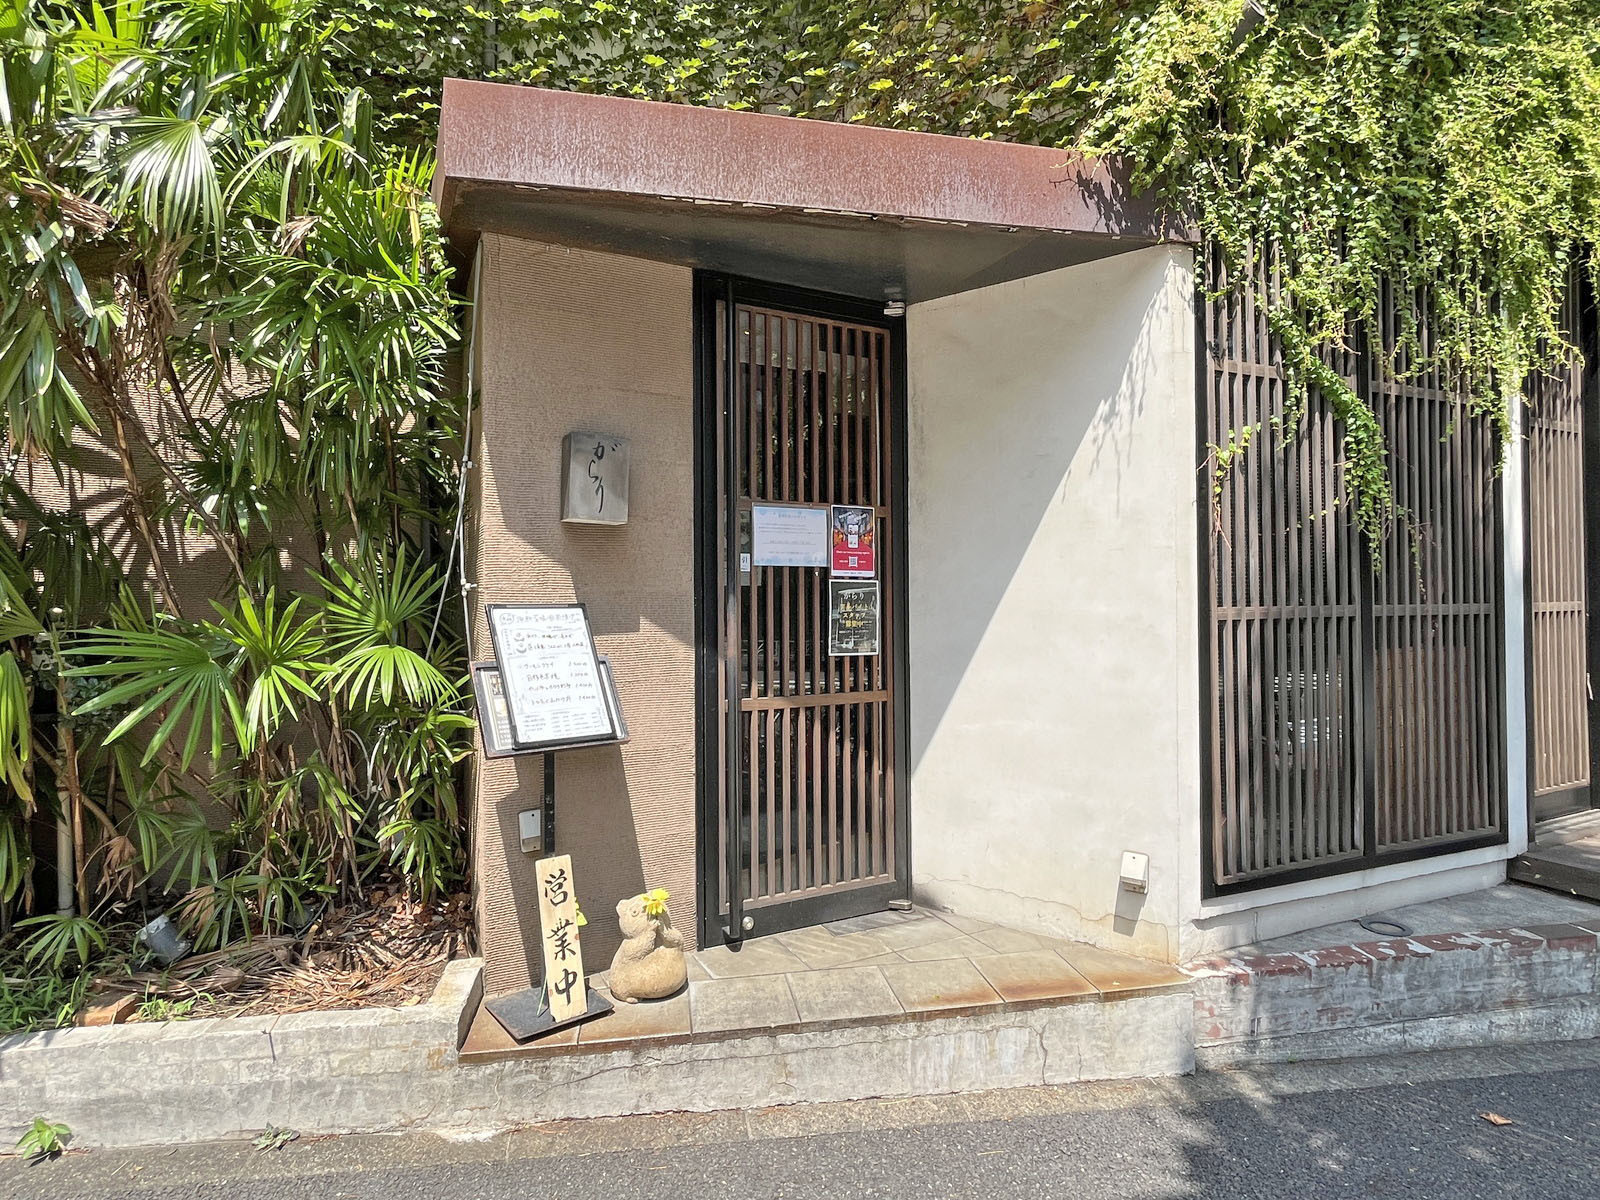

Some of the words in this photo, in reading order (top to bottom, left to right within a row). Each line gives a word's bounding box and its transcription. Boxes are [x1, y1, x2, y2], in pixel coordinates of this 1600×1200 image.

[587, 441, 623, 514] がらり
[544, 868, 578, 1007] 営業中
